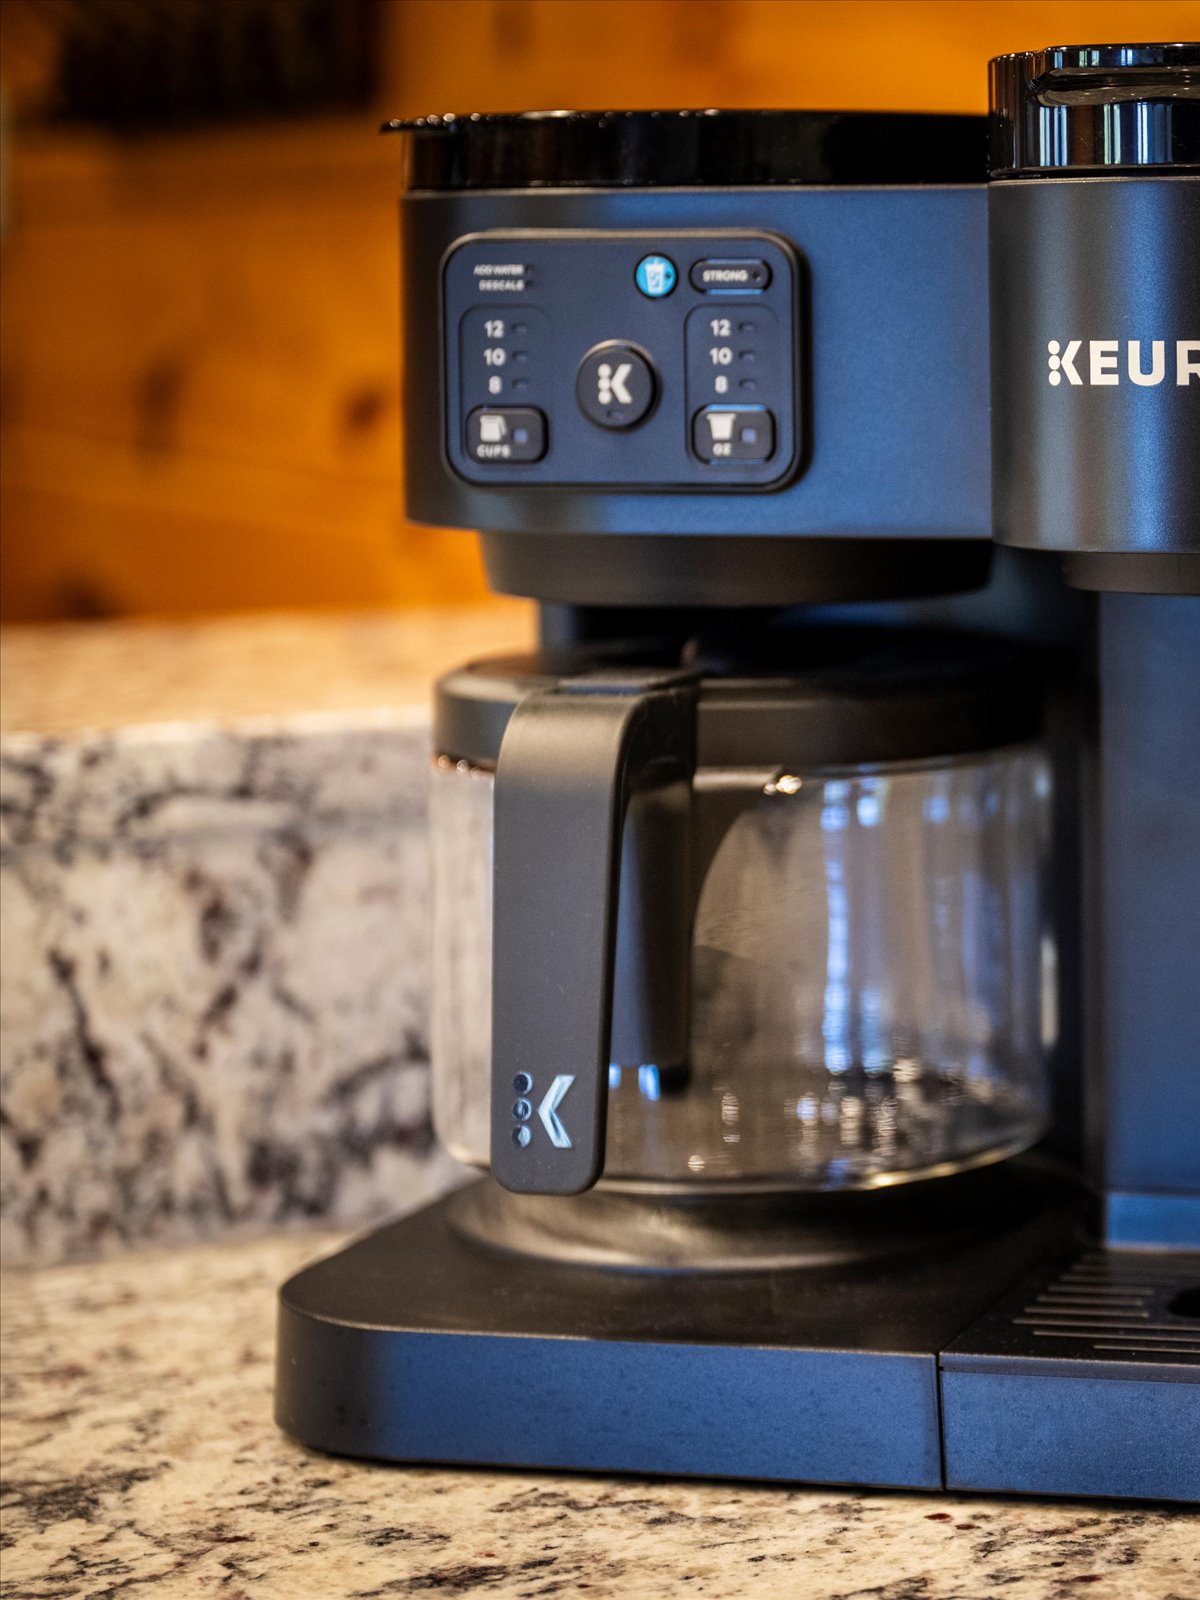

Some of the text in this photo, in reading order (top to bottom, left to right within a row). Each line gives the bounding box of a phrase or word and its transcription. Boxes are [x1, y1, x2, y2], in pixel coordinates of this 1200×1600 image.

[702, 269, 748, 282] STRONG
[484, 319, 504, 338] 12
[710, 318, 731, 337] 12
[483, 347, 505, 366] 10
[709, 346, 732, 365] 10
[488, 375, 502, 394] 8
[714, 375, 728, 394] 8
